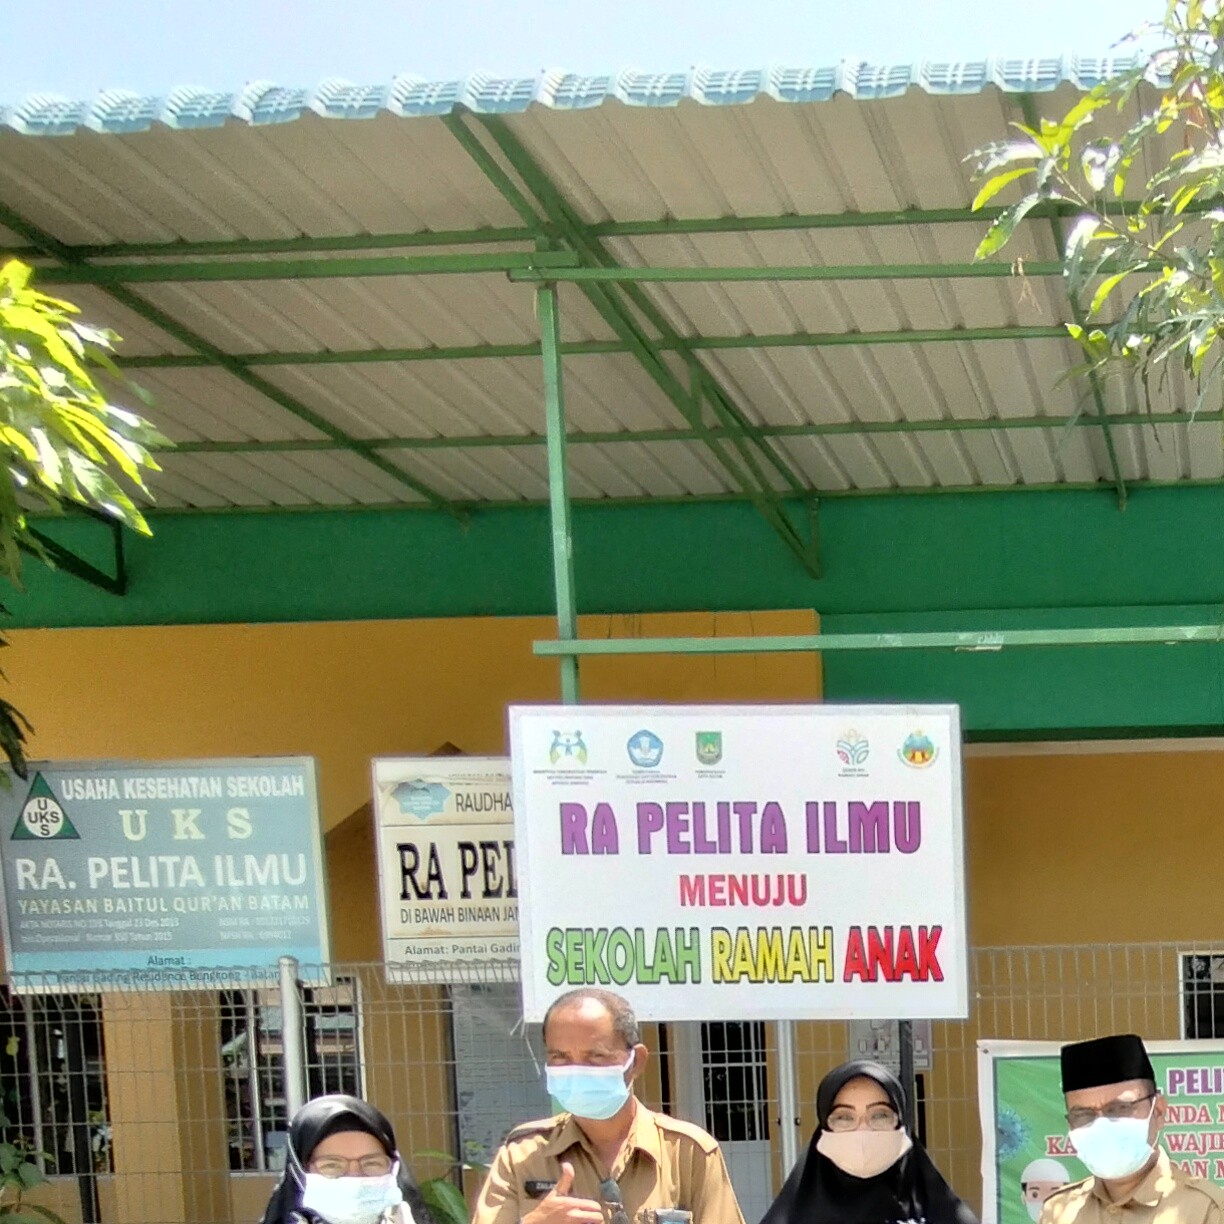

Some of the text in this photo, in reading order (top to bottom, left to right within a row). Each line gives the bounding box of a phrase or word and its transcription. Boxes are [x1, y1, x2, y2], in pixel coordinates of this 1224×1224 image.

[61, 775, 304, 800] USAHA KESEHATAN SEKOLAH
[455, 791, 514, 813] RAUDHA
[27, 811, 60, 824] UKS
[559, 801, 921, 855] RA PELITA ILMU
[15, 853, 308, 890] RA. PELITA ILMU
[396, 840, 518, 900] RA PEL
[680, 874, 808, 907] MENUJU
[19, 895, 309, 914] YAYASAN BAITUL QUR'AN BATAM
[401, 906, 518, 924] DI BAWAH BINAAN JA
[452, 945, 488, 954] Pantai
[546, 926, 944, 985] SEKOLAH RAMAH ANAK
[1163, 1105, 1212, 1123] NDA
[1171, 1161, 1209, 1178] AN
